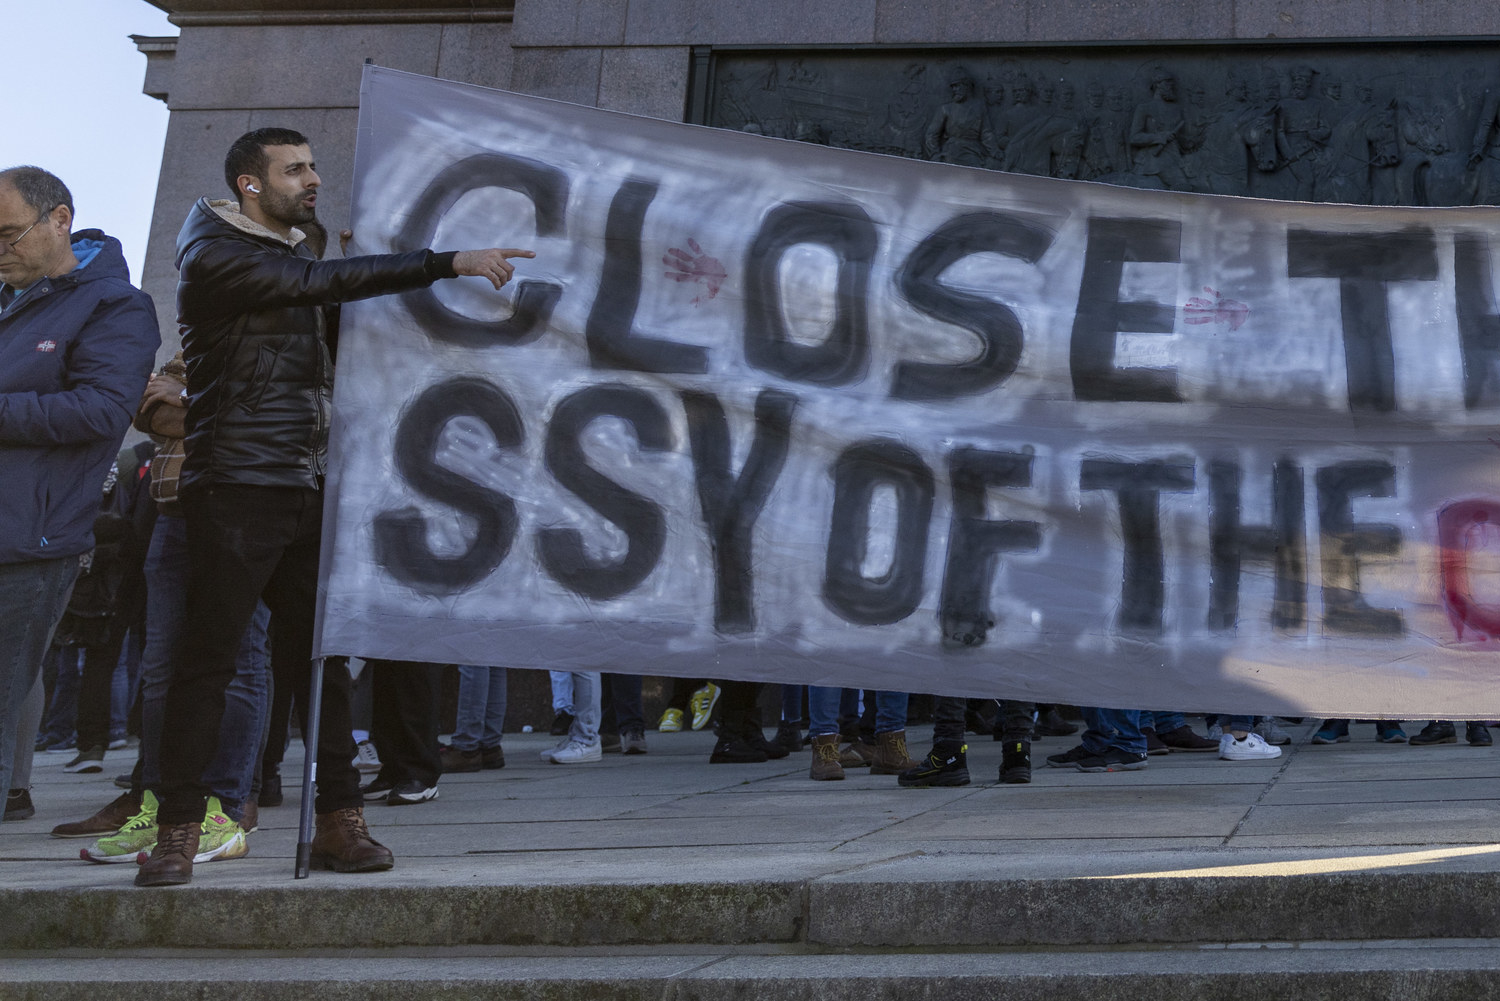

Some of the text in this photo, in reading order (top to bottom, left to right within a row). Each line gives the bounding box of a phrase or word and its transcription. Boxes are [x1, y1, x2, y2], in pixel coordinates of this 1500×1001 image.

[393, 152, 1184, 402] CLOSE
[373, 376, 800, 633] SSY
[822, 436, 1044, 646] OF
[1080, 454, 1405, 633] THE
